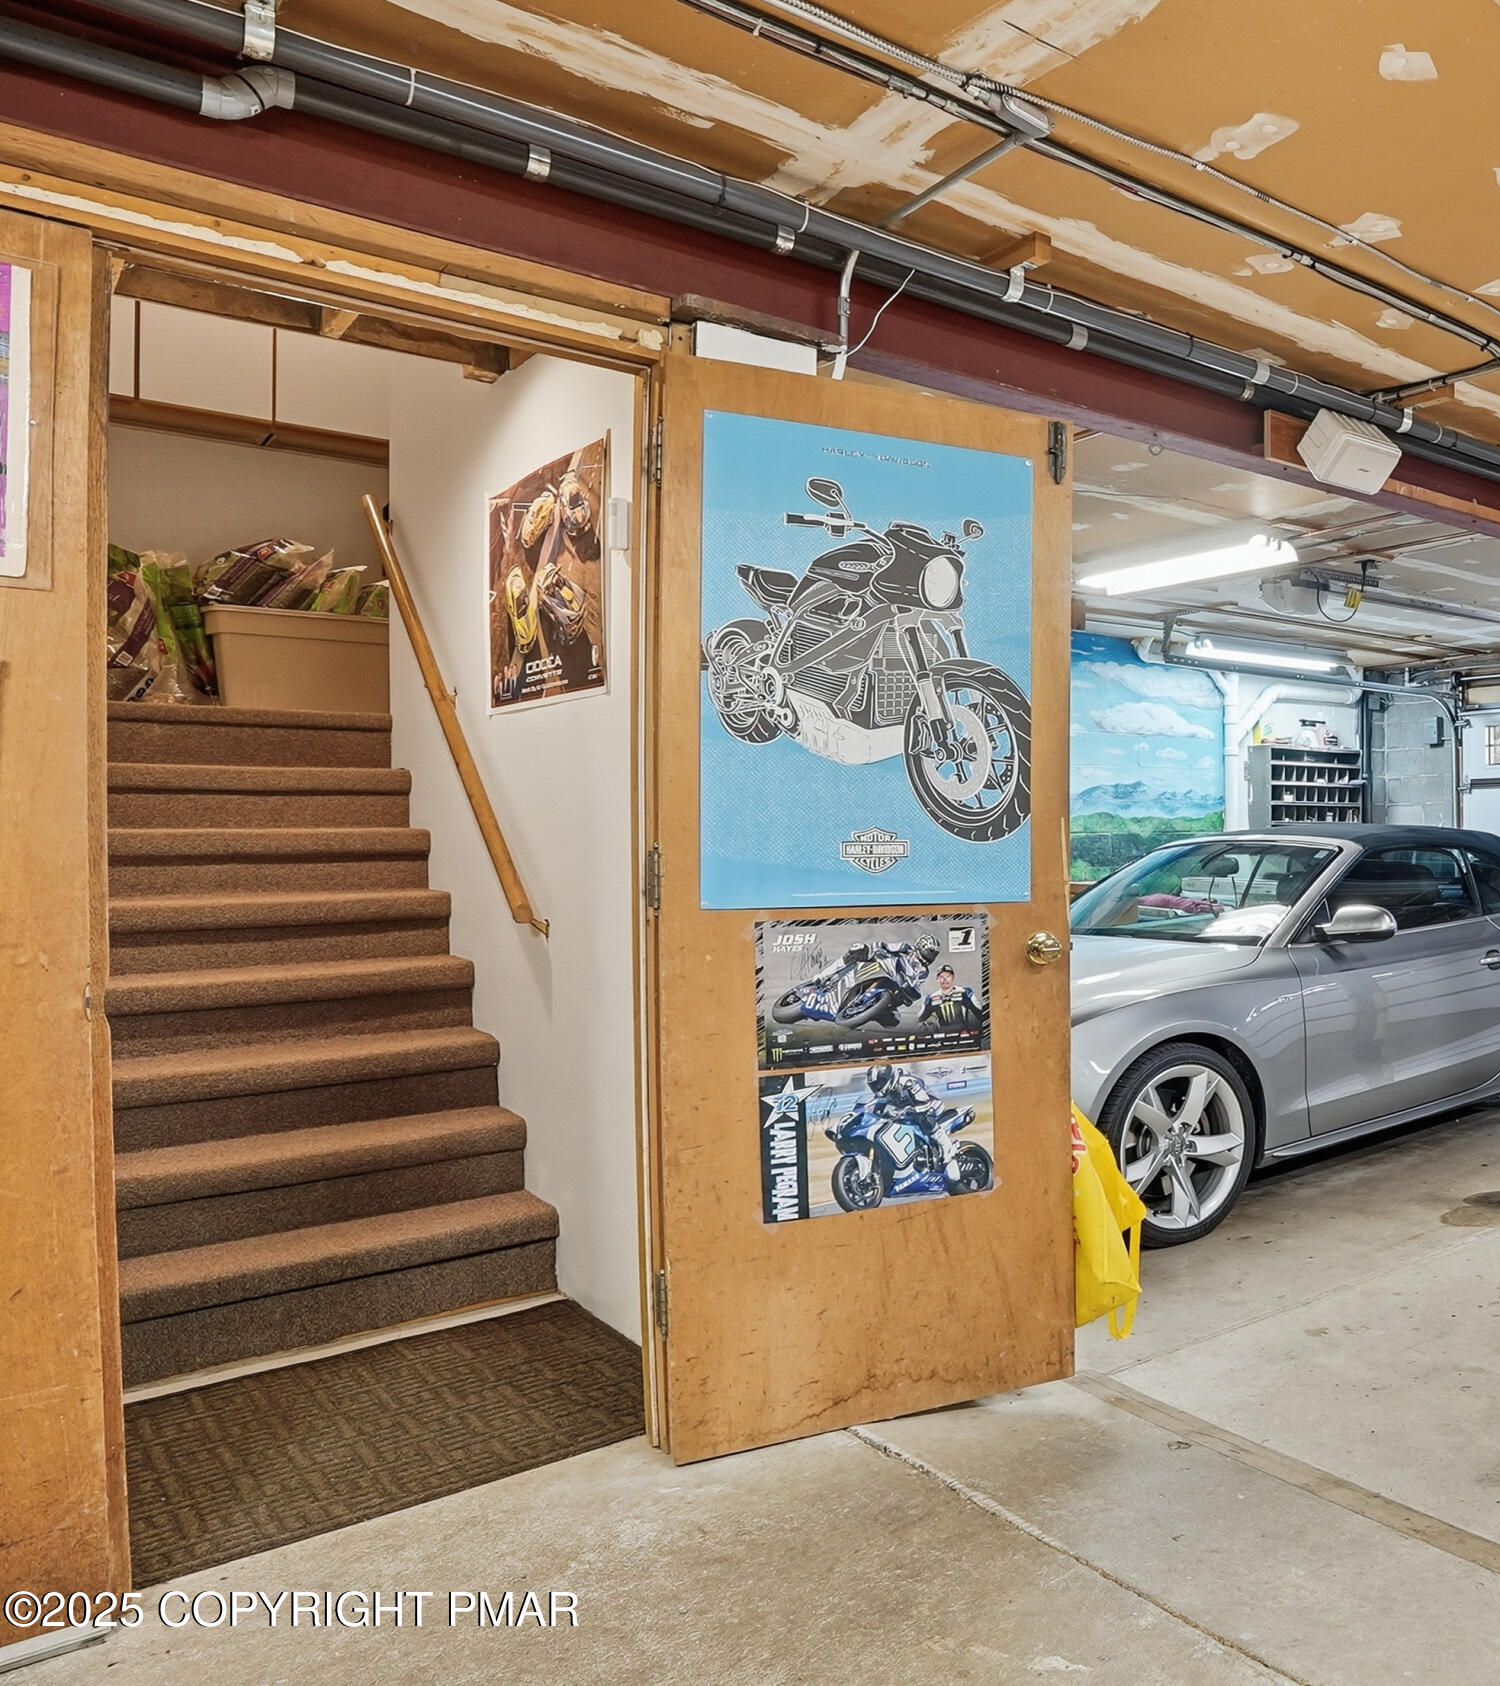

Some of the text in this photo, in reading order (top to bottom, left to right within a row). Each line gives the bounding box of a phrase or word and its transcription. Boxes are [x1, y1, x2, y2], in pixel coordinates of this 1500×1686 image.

[772, 934, 817, 946] JOSH
[772, 944, 804, 953] HAYES
[769, 1121, 799, 1222] LARRY PEGRAM
